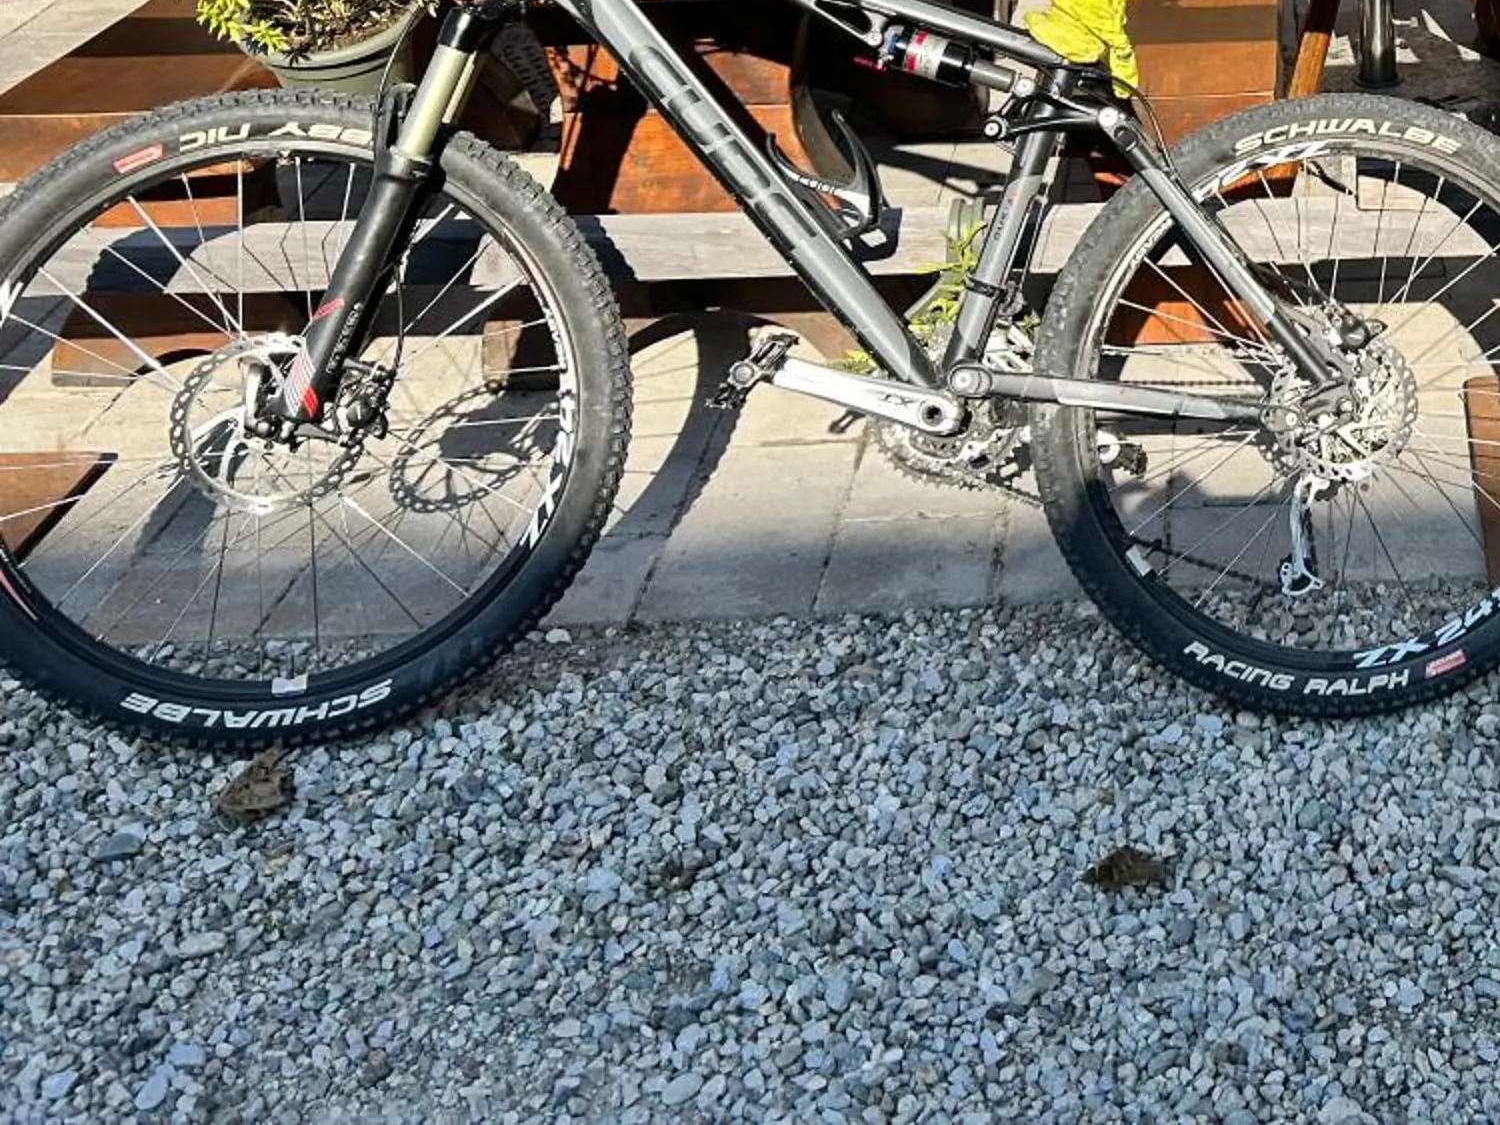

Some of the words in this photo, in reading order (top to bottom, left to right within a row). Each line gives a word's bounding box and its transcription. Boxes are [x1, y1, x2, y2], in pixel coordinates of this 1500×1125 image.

[1233, 117, 1462, 158] SCHWALBE
[1183, 640, 1295, 691] RACING
[1303, 668, 1410, 696] RALPH
[118, 677, 394, 729] SCHWALBE
